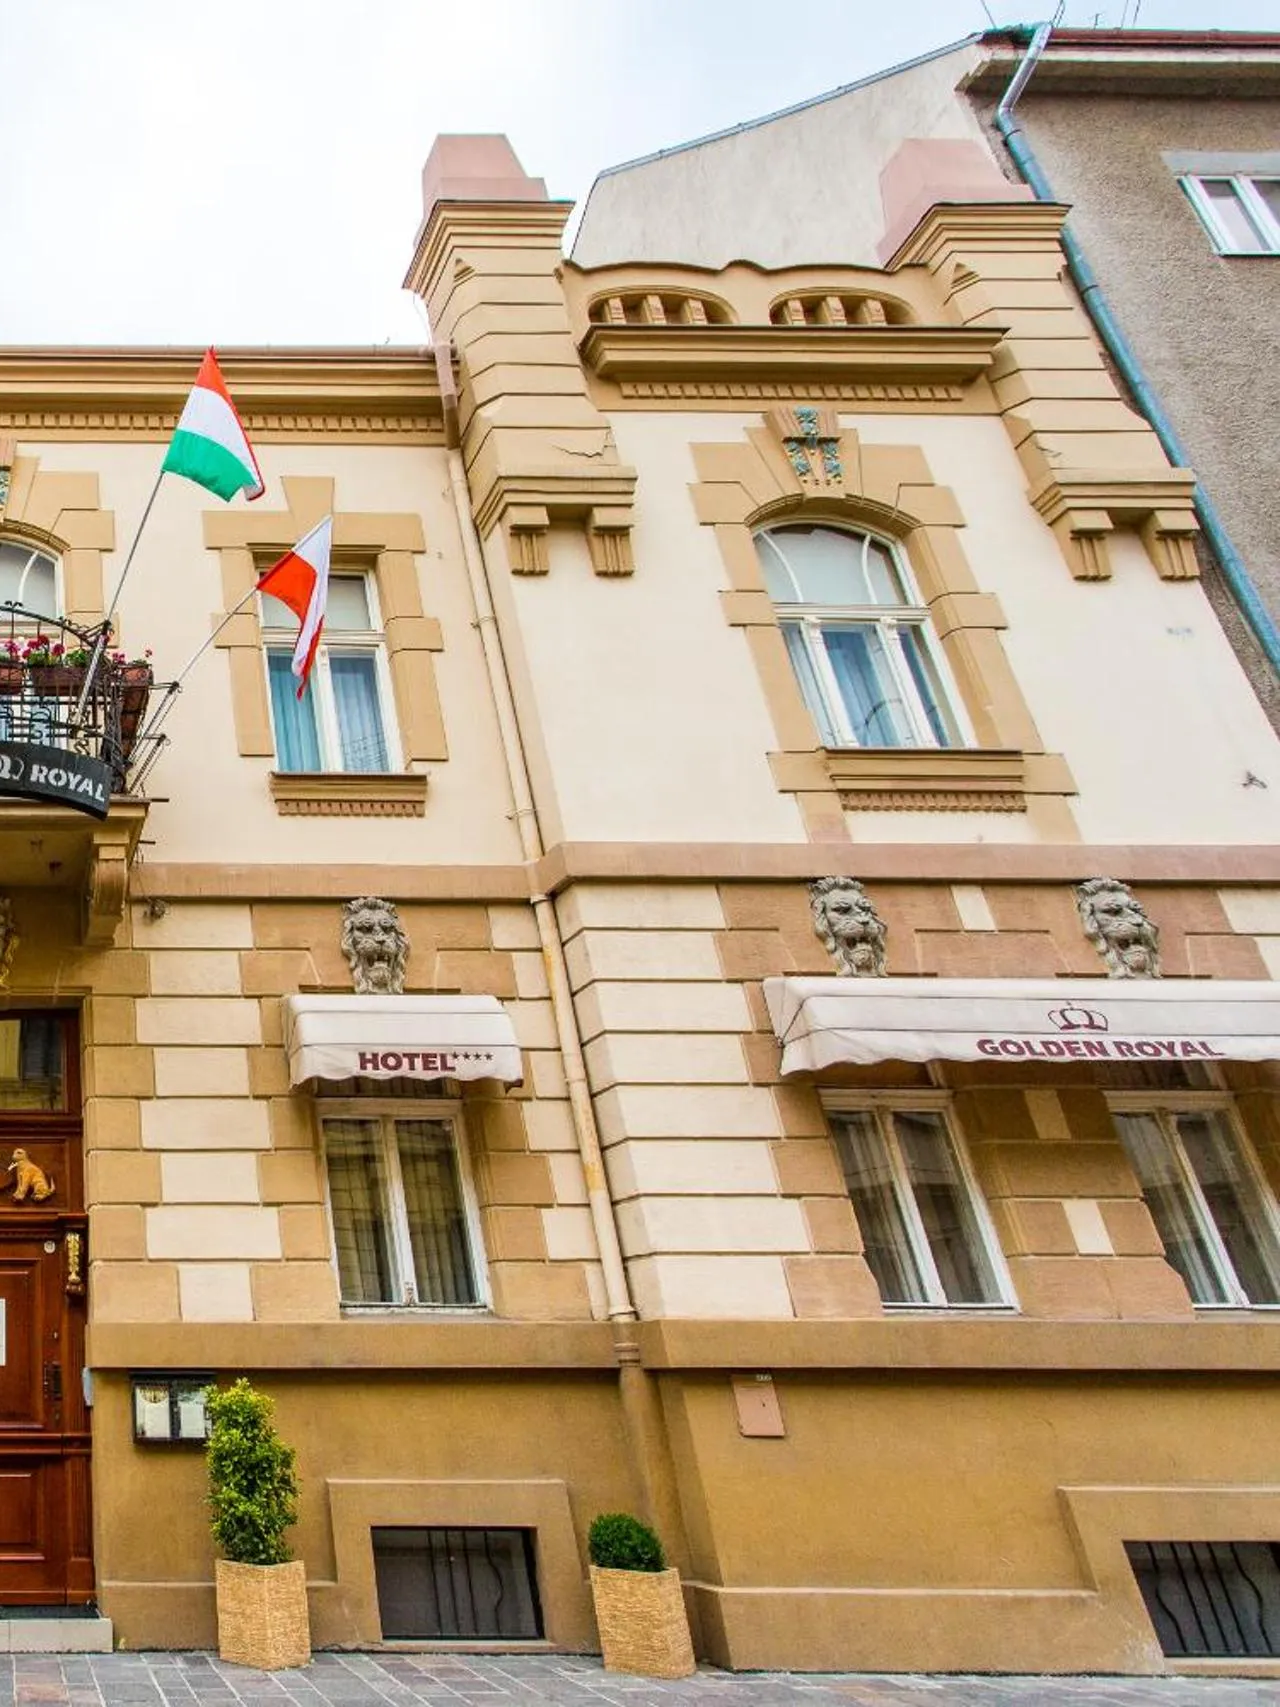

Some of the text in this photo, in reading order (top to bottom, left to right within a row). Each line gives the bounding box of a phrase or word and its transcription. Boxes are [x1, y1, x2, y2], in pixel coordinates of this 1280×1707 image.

[30, 764, 106, 802] ROYAL
[976, 1038, 1225, 1058] GOLDEN ROYAL
